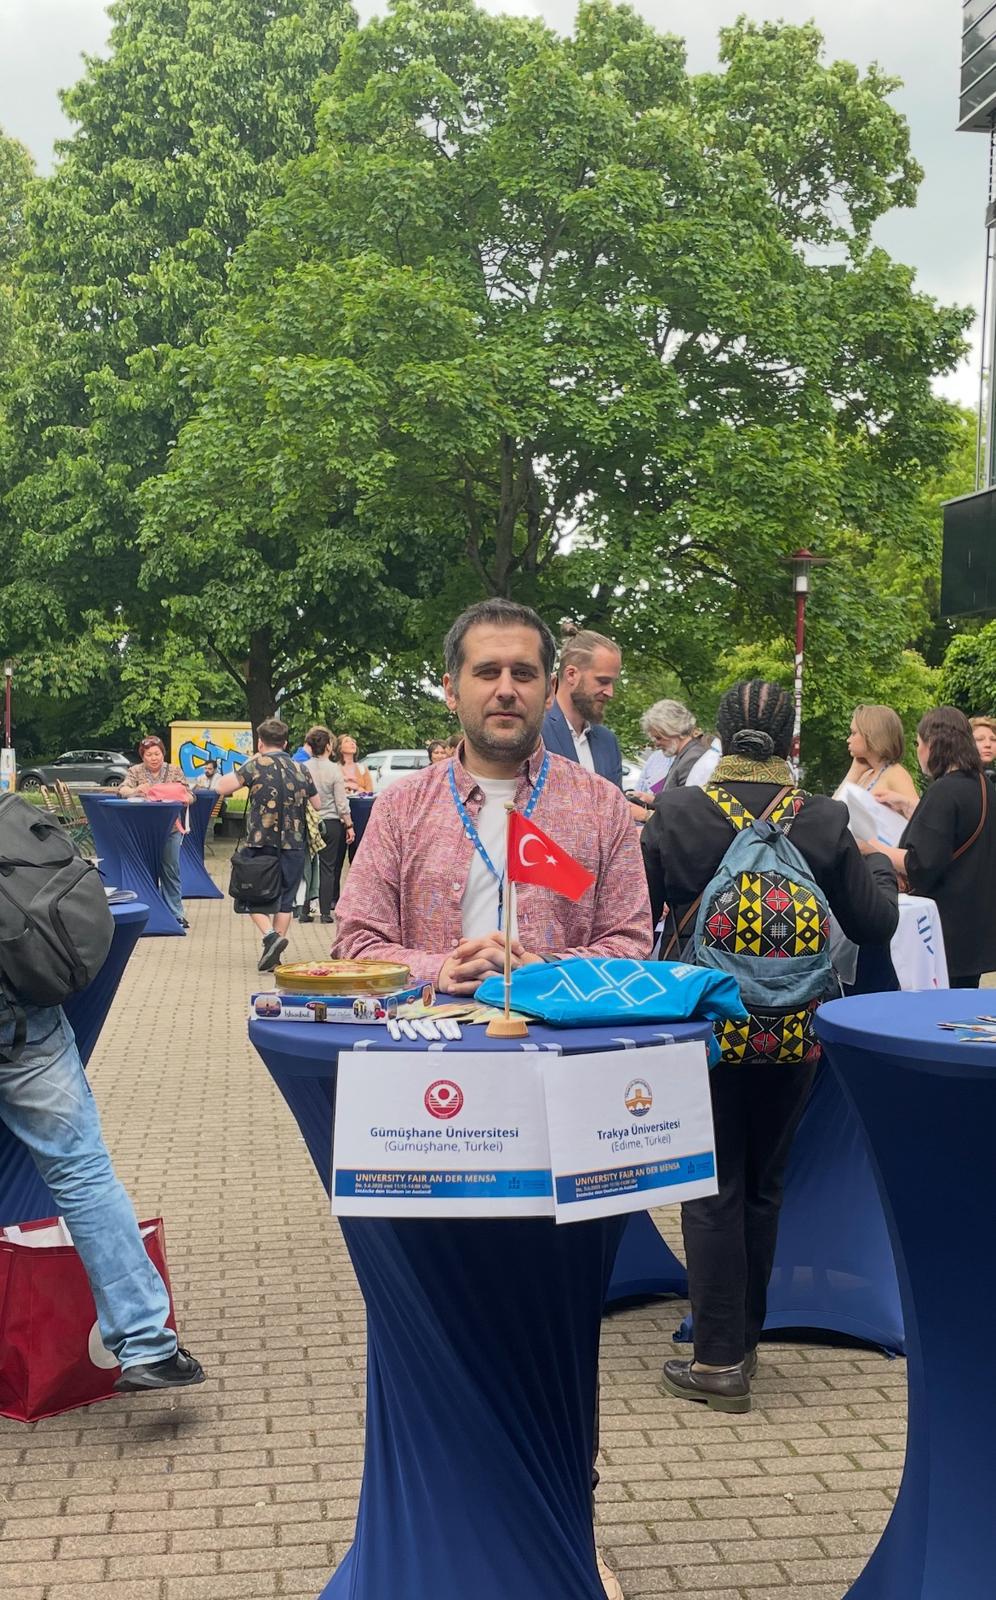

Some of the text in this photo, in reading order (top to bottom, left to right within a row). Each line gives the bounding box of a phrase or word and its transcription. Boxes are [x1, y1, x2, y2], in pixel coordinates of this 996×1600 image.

[370, 1126, 519, 1140] Gümüşhane Üniversitesi
[597, 1119, 681, 1141] Trakya Üniversitesi
[355, 1173, 497, 1183] UNIVERSITY FAIR AN DER MENSA
[575, 1172, 618, 1186] UNIVERSITY
[619, 1169, 634, 1179] FAIR
[635, 1167, 646, 1177] AN
[646, 1165, 659, 1174] DER
[659, 1162, 681, 1172] MENSA
